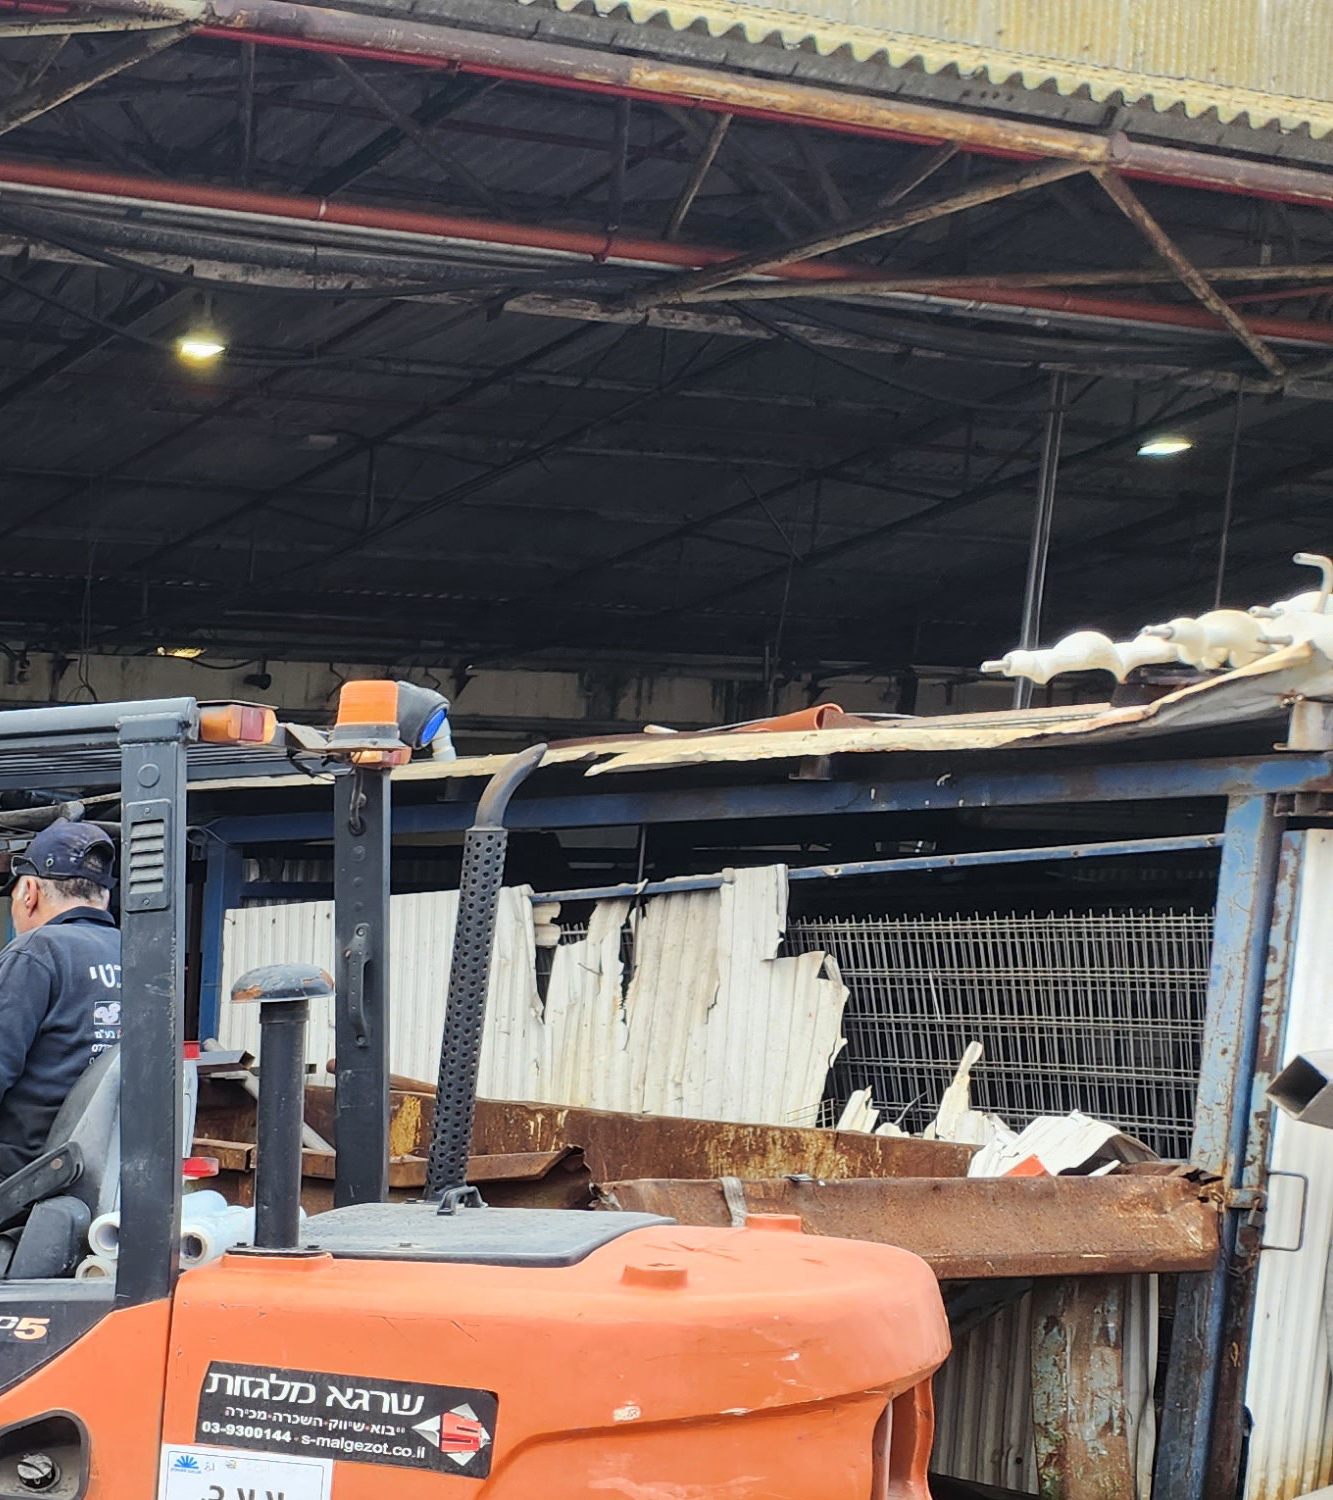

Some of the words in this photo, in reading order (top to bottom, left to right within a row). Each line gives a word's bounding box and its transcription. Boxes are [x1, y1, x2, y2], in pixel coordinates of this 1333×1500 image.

[205, 1372, 316, 1404] מלגזות
[326, 1385, 425, 1416] שרגא
[202, 1421, 292, 1442] 03-9300144
[301, 1433, 426, 1460] s-malgezot.co.il
